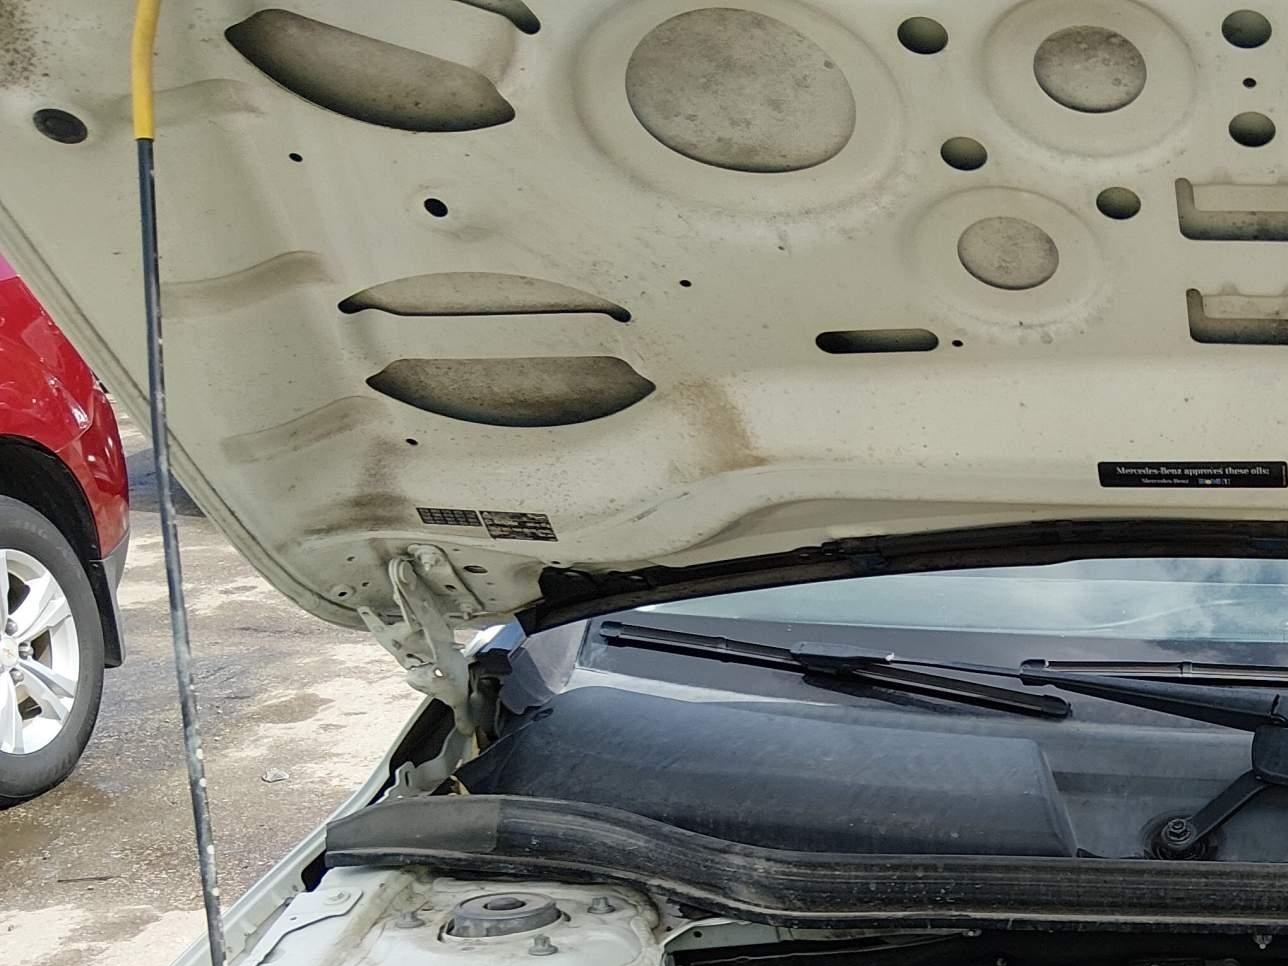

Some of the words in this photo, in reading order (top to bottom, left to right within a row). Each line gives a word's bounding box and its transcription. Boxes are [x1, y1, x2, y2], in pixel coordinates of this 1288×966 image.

[1116, 466, 1182, 475] Mercedes-Benz
[1184, 467, 1224, 476] approves
[1225, 466, 1250, 475] these
